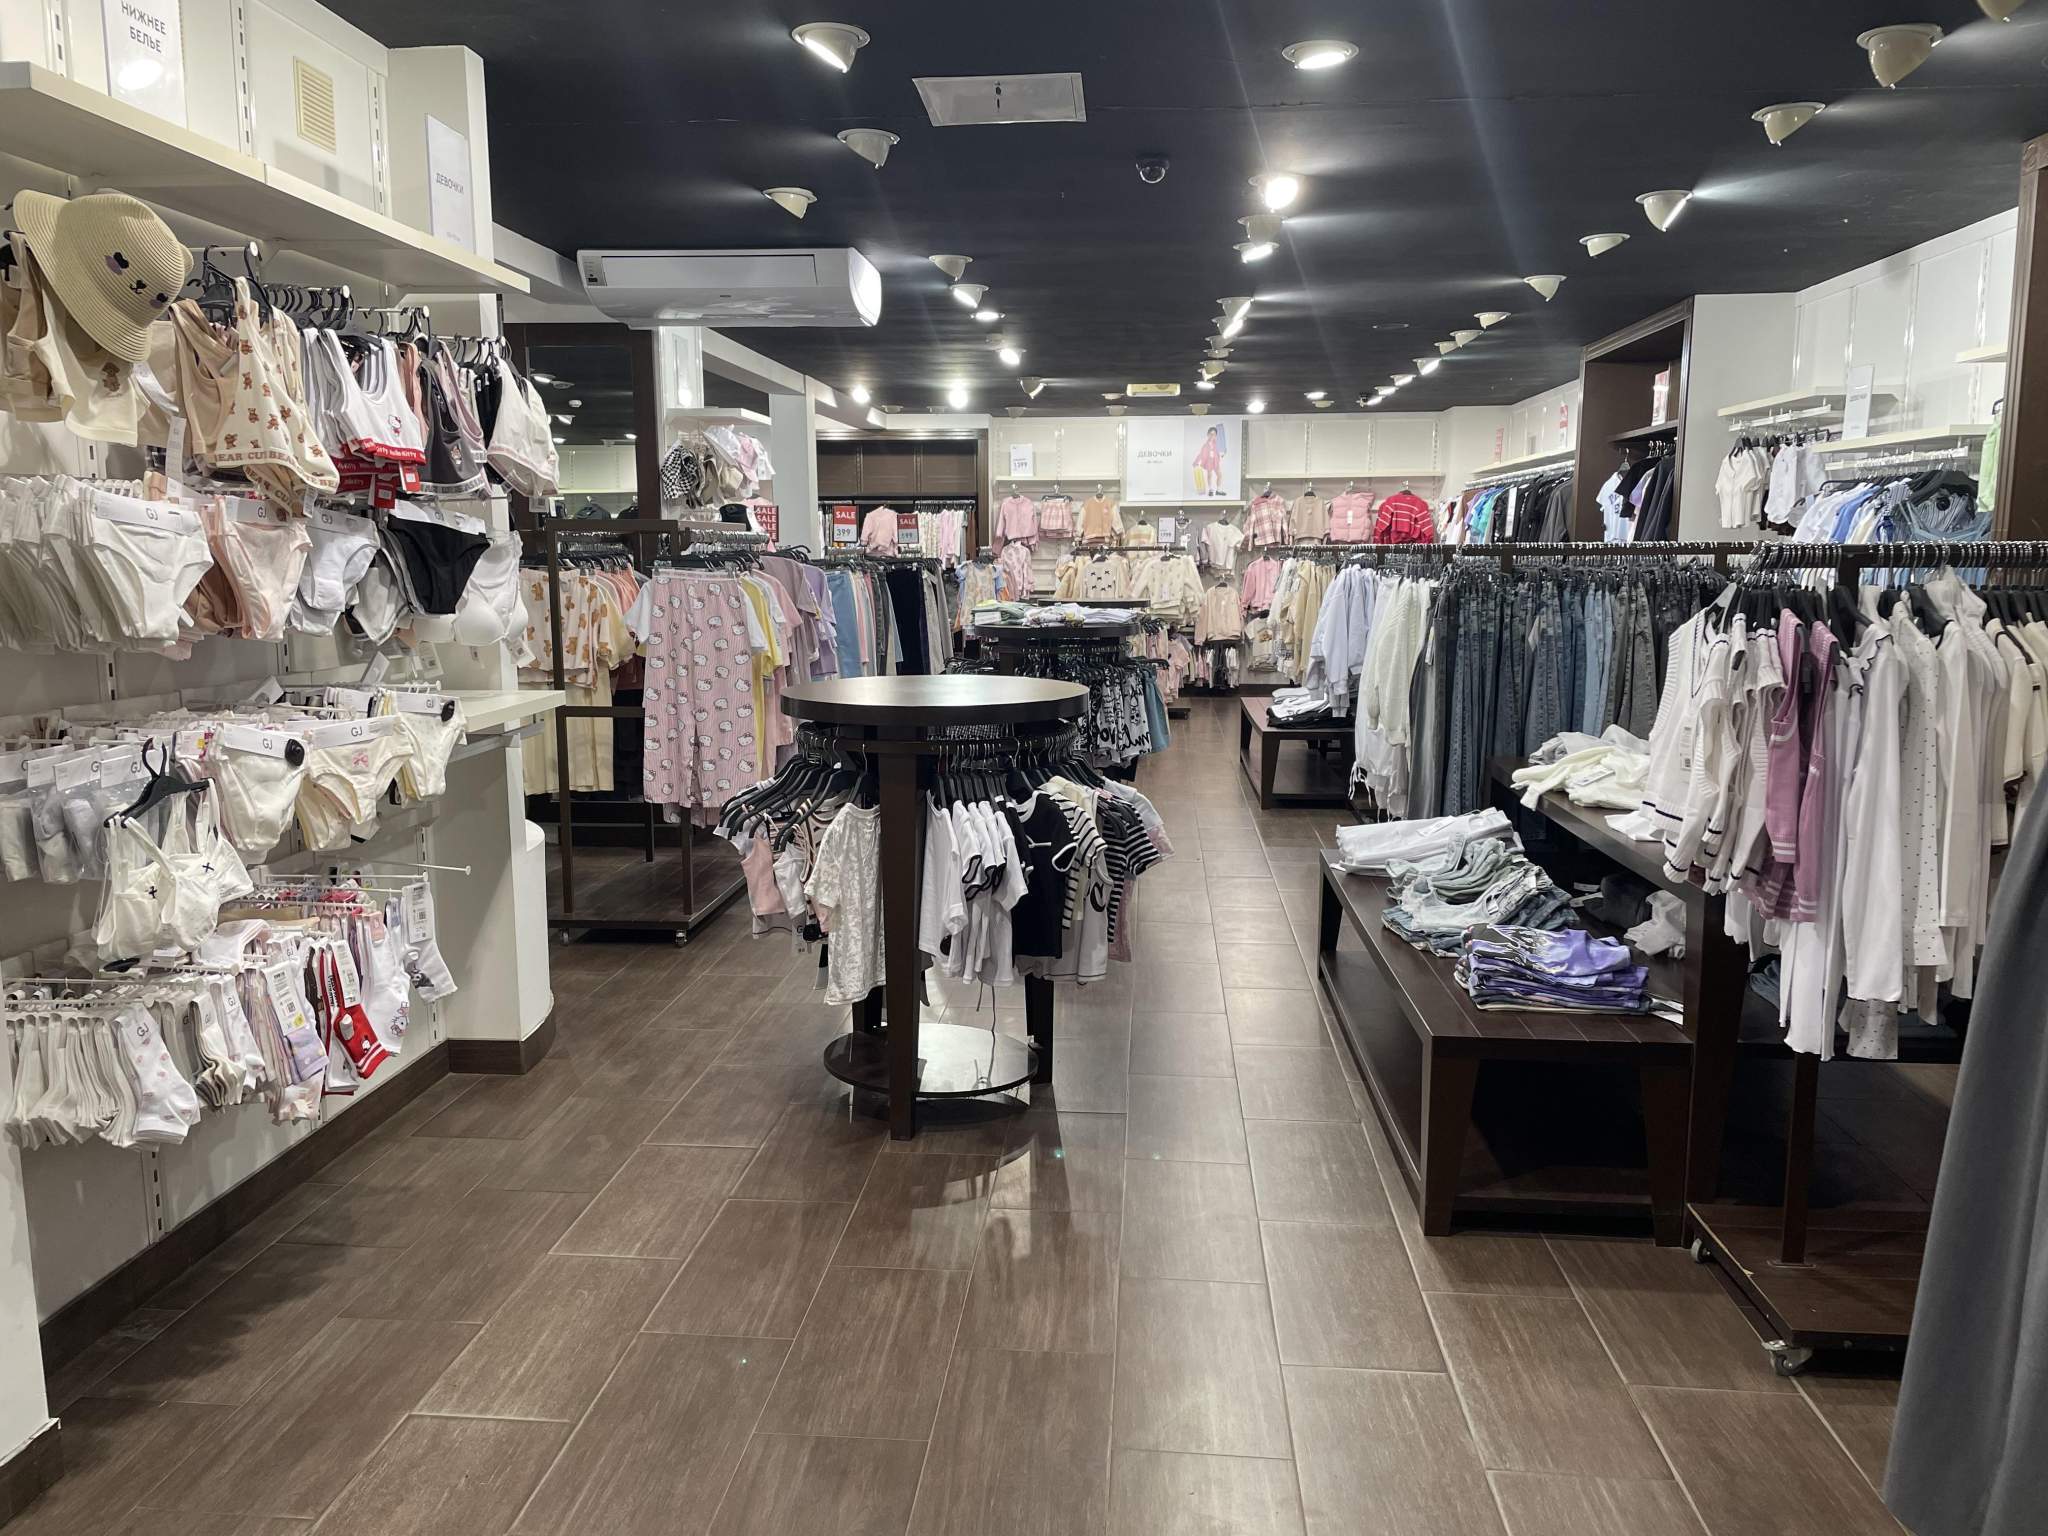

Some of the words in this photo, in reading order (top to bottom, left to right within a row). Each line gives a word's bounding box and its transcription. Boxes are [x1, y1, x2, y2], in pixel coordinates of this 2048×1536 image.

[121, 0, 166, 35] НИЖНЕЕ
[129, 26, 162, 53] БЕЛЬЕ
[435, 172, 464, 195] ДЕВОЧКИ
[215, 453, 242, 461] EAR
[146, 507, 159, 521] GJ
[257, 506, 267, 518] GJ
[351, 726, 363, 737] GJ
[262, 738, 273, 749] GJ
[130, 761, 142, 773] GJ
[136, 1023, 150, 1037] GJ
